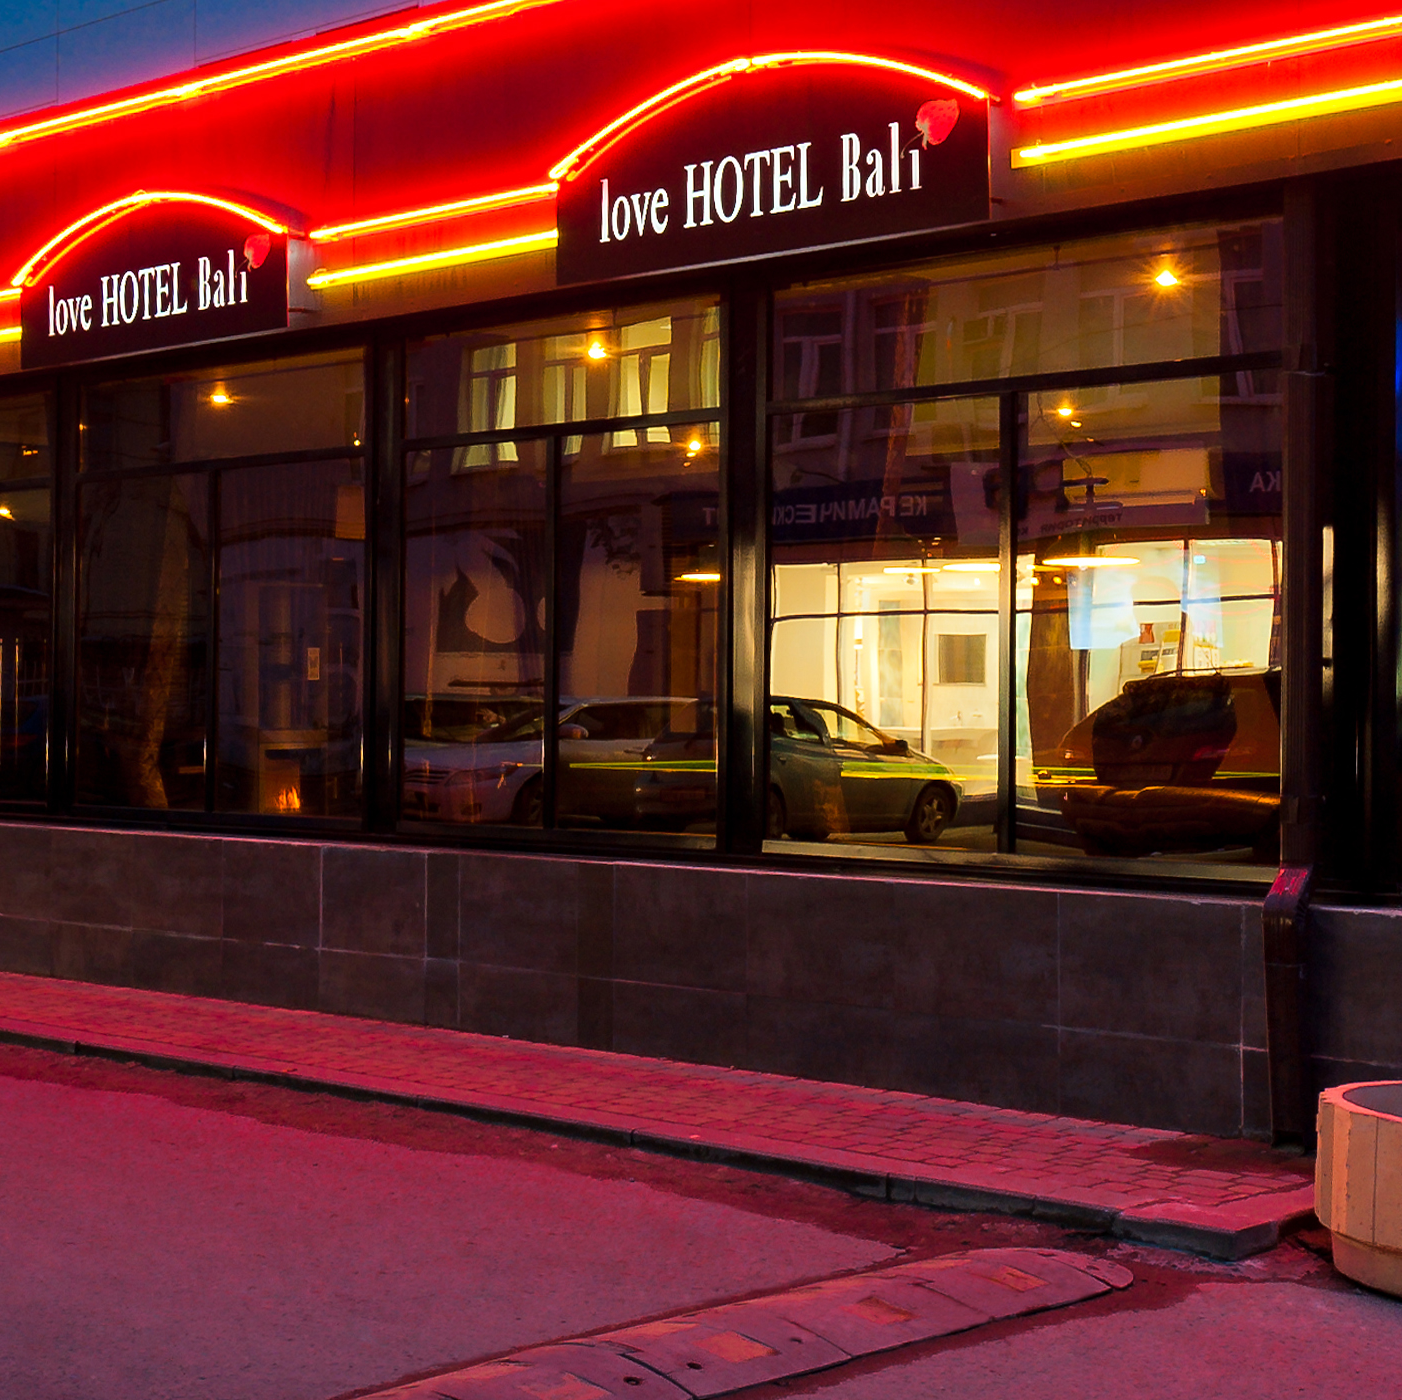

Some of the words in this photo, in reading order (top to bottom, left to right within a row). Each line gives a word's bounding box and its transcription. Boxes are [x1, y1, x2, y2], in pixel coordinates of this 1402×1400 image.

[599, 178, 670, 244] love
[683, 141, 825, 229] HOTEL
[839, 121, 923, 203] Bali
[47, 285, 93, 337] love
[100, 261, 189, 328] HOTEL
[197, 248, 249, 312] Bali
